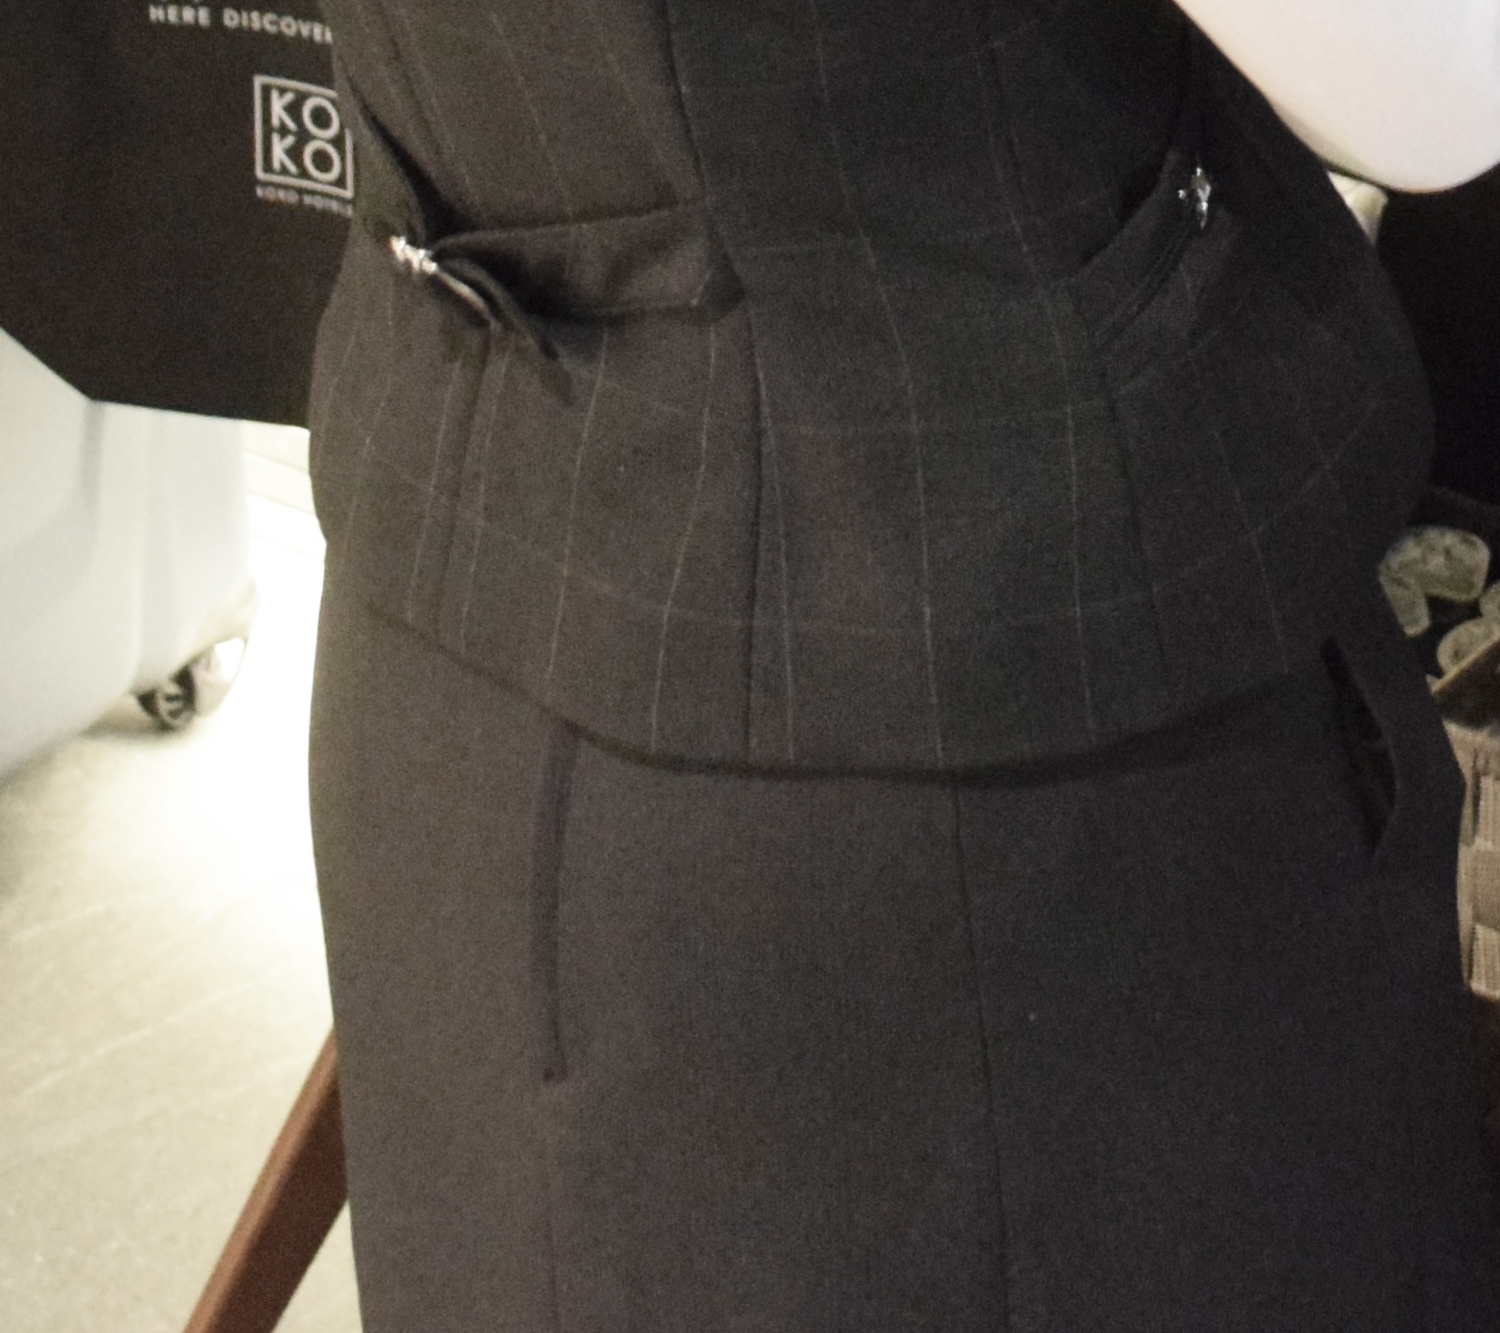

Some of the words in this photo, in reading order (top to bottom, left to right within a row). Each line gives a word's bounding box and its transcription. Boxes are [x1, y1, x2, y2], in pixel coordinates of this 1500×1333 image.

[148, 4, 211, 27] HERE
[270, 88, 340, 140] KO
[271, 132, 341, 183] KO
